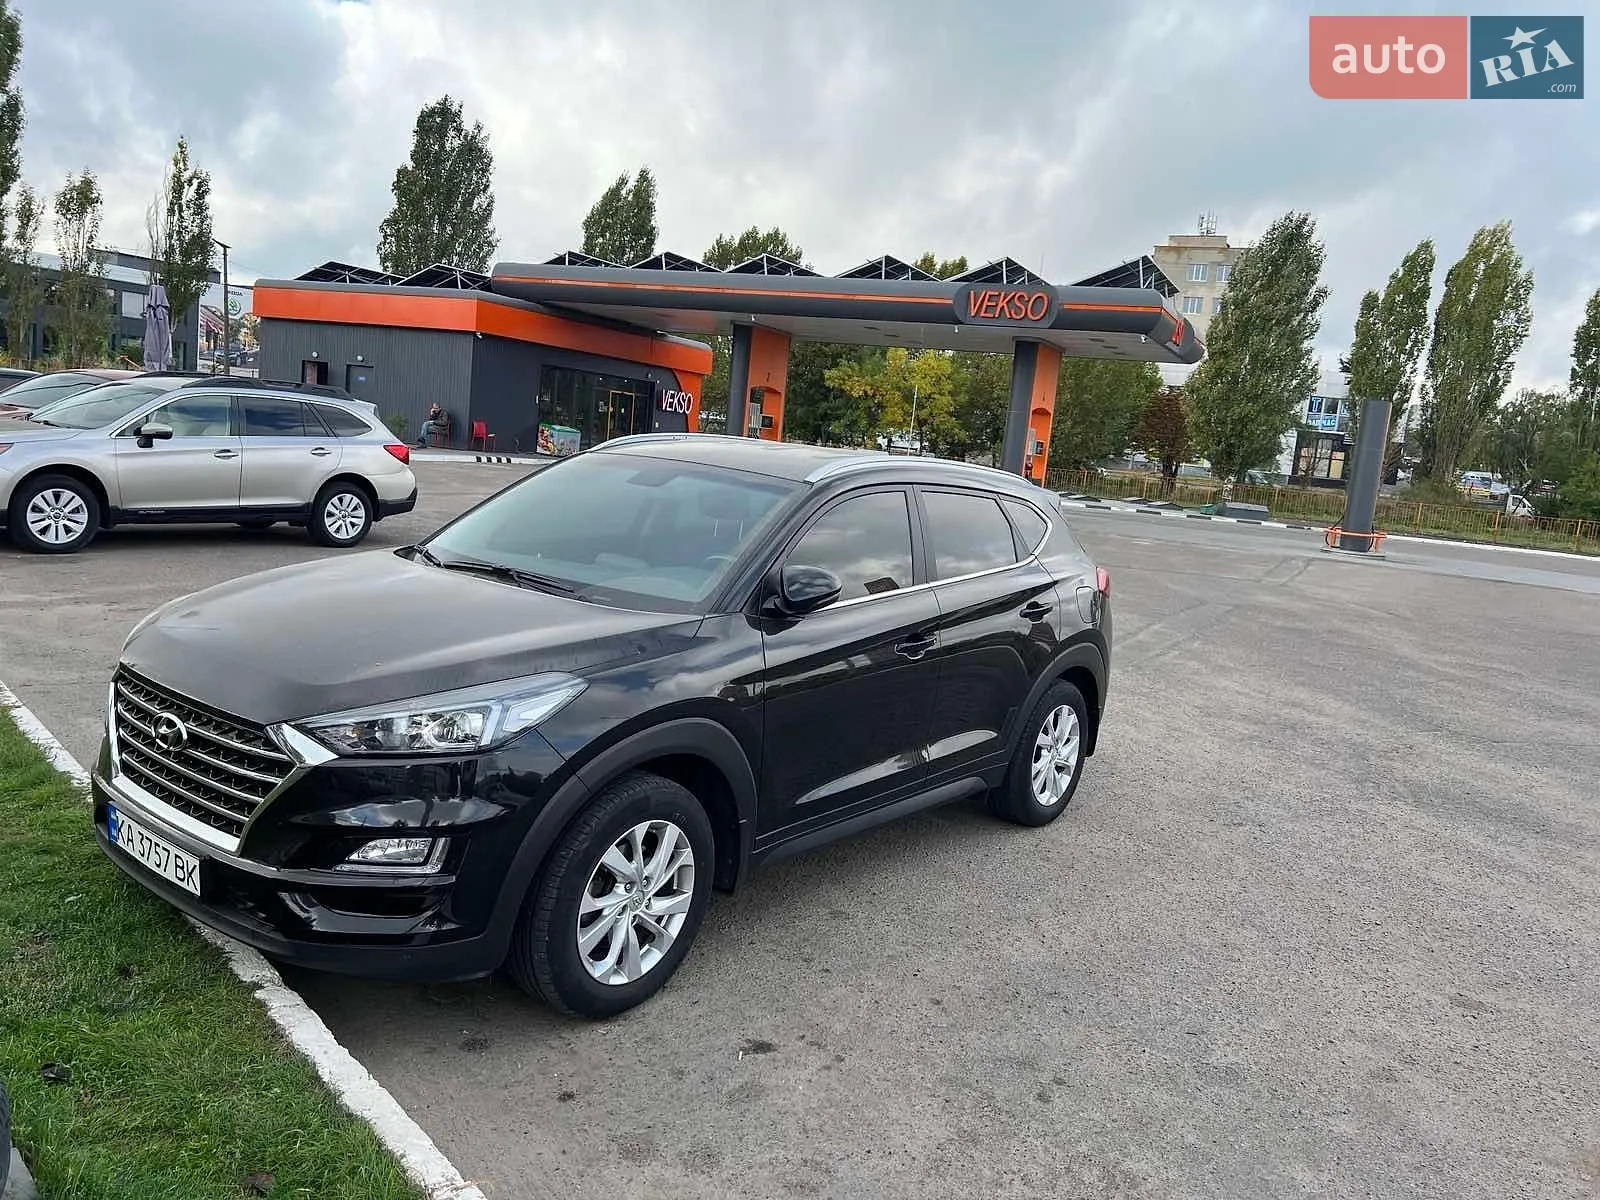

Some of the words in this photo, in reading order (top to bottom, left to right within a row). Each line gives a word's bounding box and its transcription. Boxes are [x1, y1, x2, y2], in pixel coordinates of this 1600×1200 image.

[969, 289, 1049, 320] VEKSO
[662, 388, 693, 414] VEKSO
[115, 815, 135, 851] KA
[138, 830, 170, 872] 3757
[175, 853, 198, 892] BK
